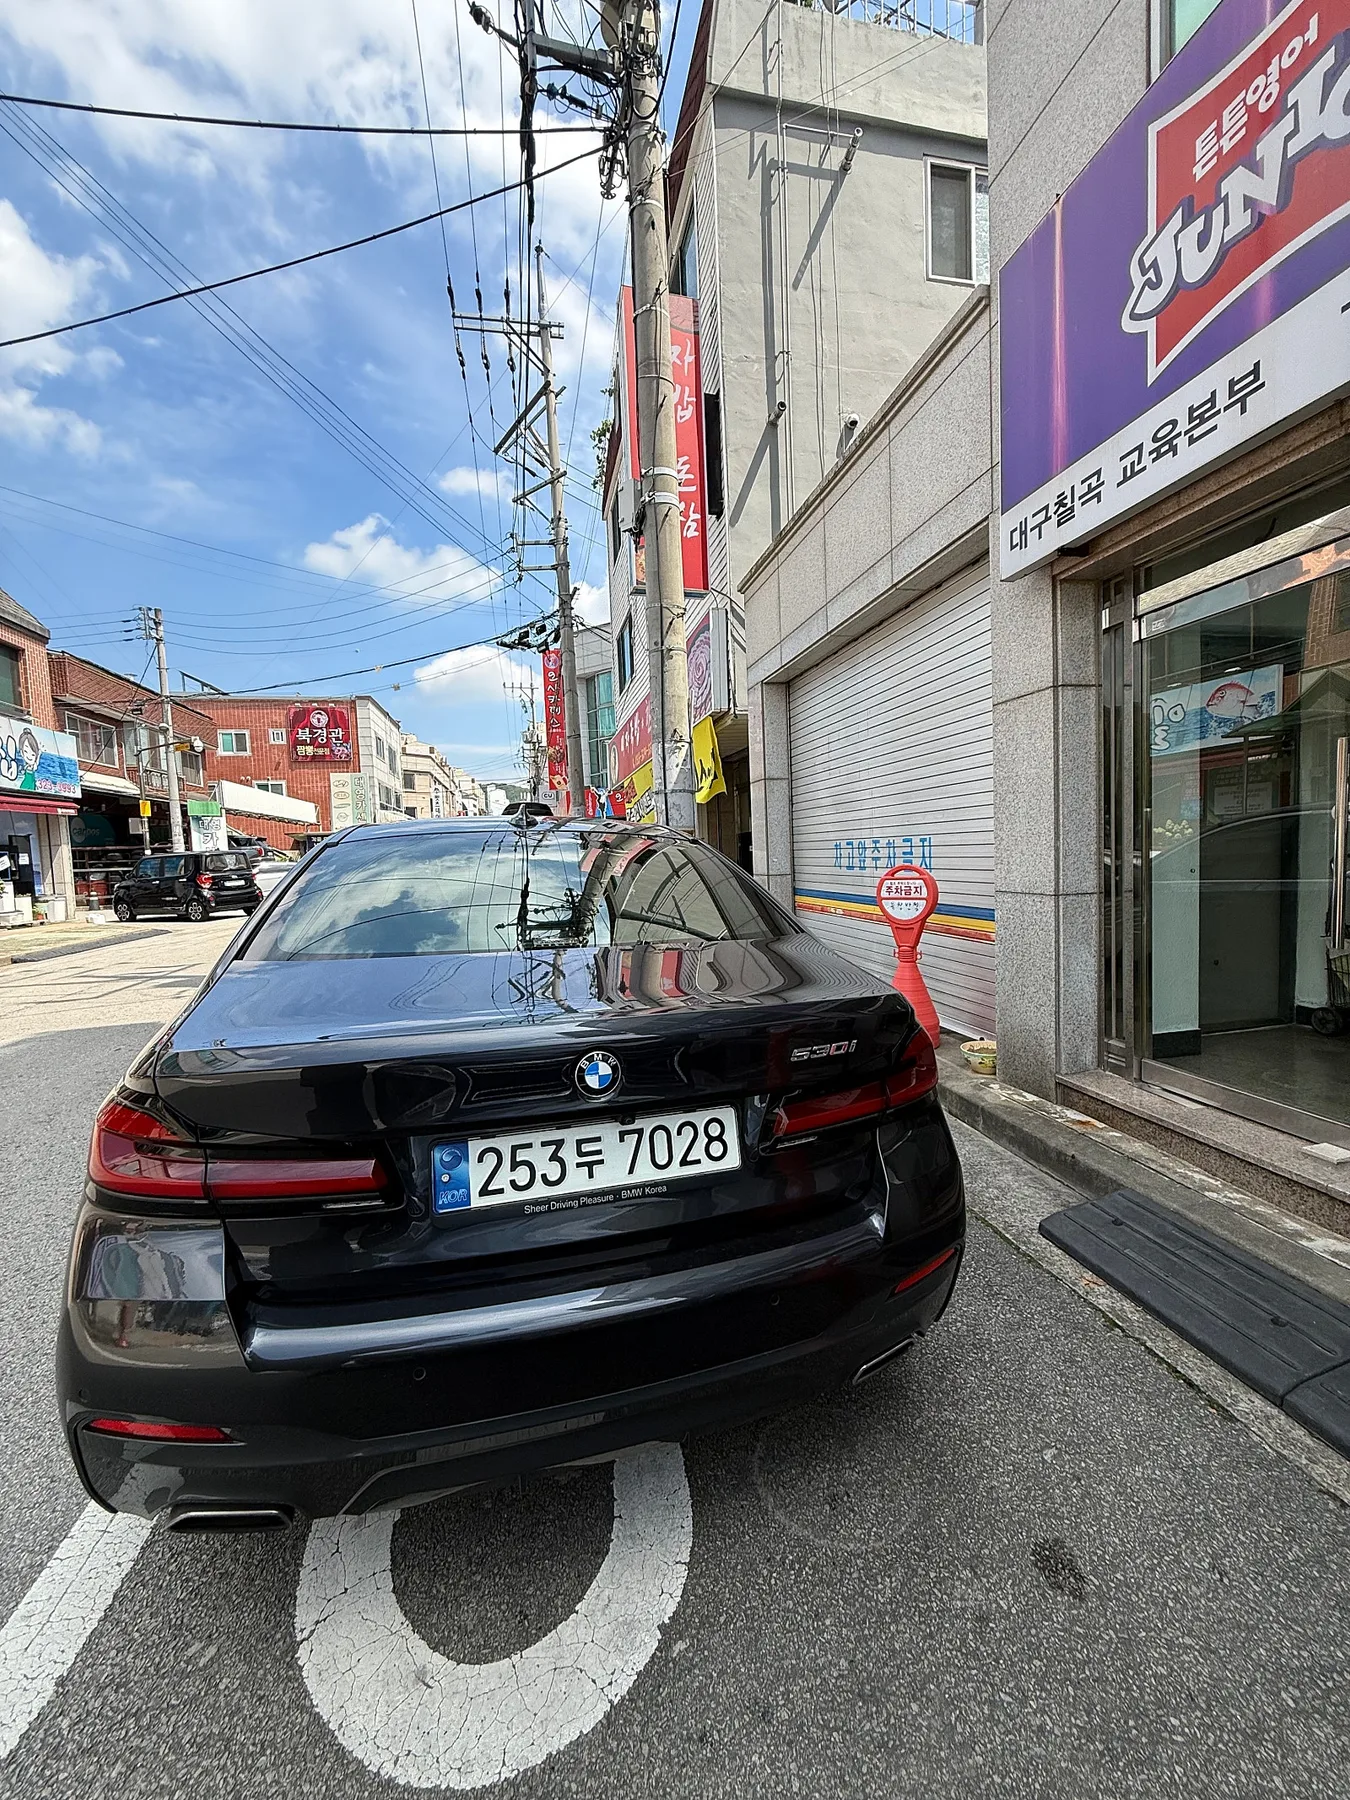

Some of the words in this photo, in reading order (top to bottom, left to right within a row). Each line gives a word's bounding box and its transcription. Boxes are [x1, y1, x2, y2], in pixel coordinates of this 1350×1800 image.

[1192, 12, 1319, 183] 튼튼영어
[1009, 465, 1105, 552] 대구칠곡
[1117, 359, 1266, 488] 교육본부
[296, 727, 345, 746] 북경관
[885, 886, 922, 896] 주차금지
[580, 1053, 617, 1070] BMW
[791, 1039, 858, 1062] 530i
[476, 1136, 606, 1198] 253두
[617, 1116, 729, 1176] 7028
[438, 1188, 468, 1206] KOR
[523, 1201, 549, 1215] Sheer
[550, 1197, 579, 1213] Driving
[579, 1192, 614, 1208] Pleasure
[621, 1187, 643, 1199] BMW
[645, 1183, 668, 1196] Korea
